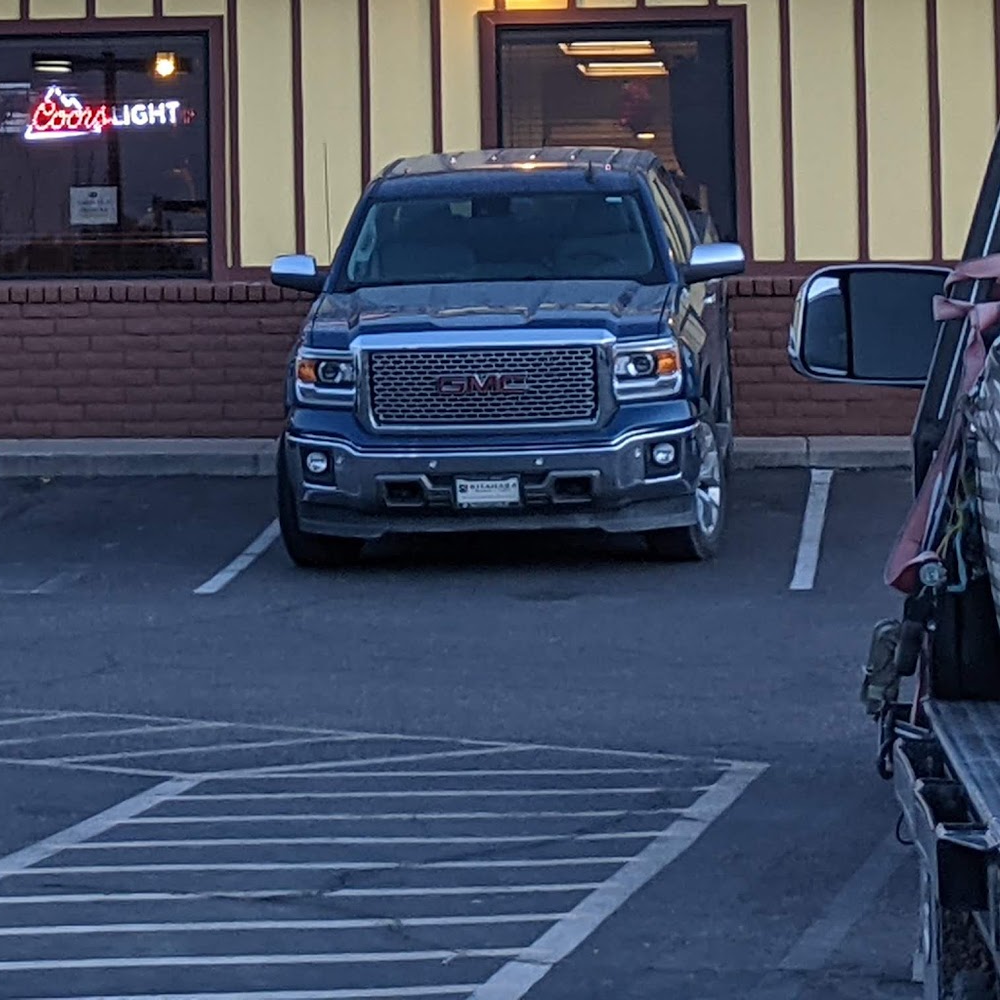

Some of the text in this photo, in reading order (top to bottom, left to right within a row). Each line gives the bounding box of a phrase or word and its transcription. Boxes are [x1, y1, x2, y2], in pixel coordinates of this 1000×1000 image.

[32, 101, 180, 131] Coors LIGHT
[438, 373, 529, 395] GMC
